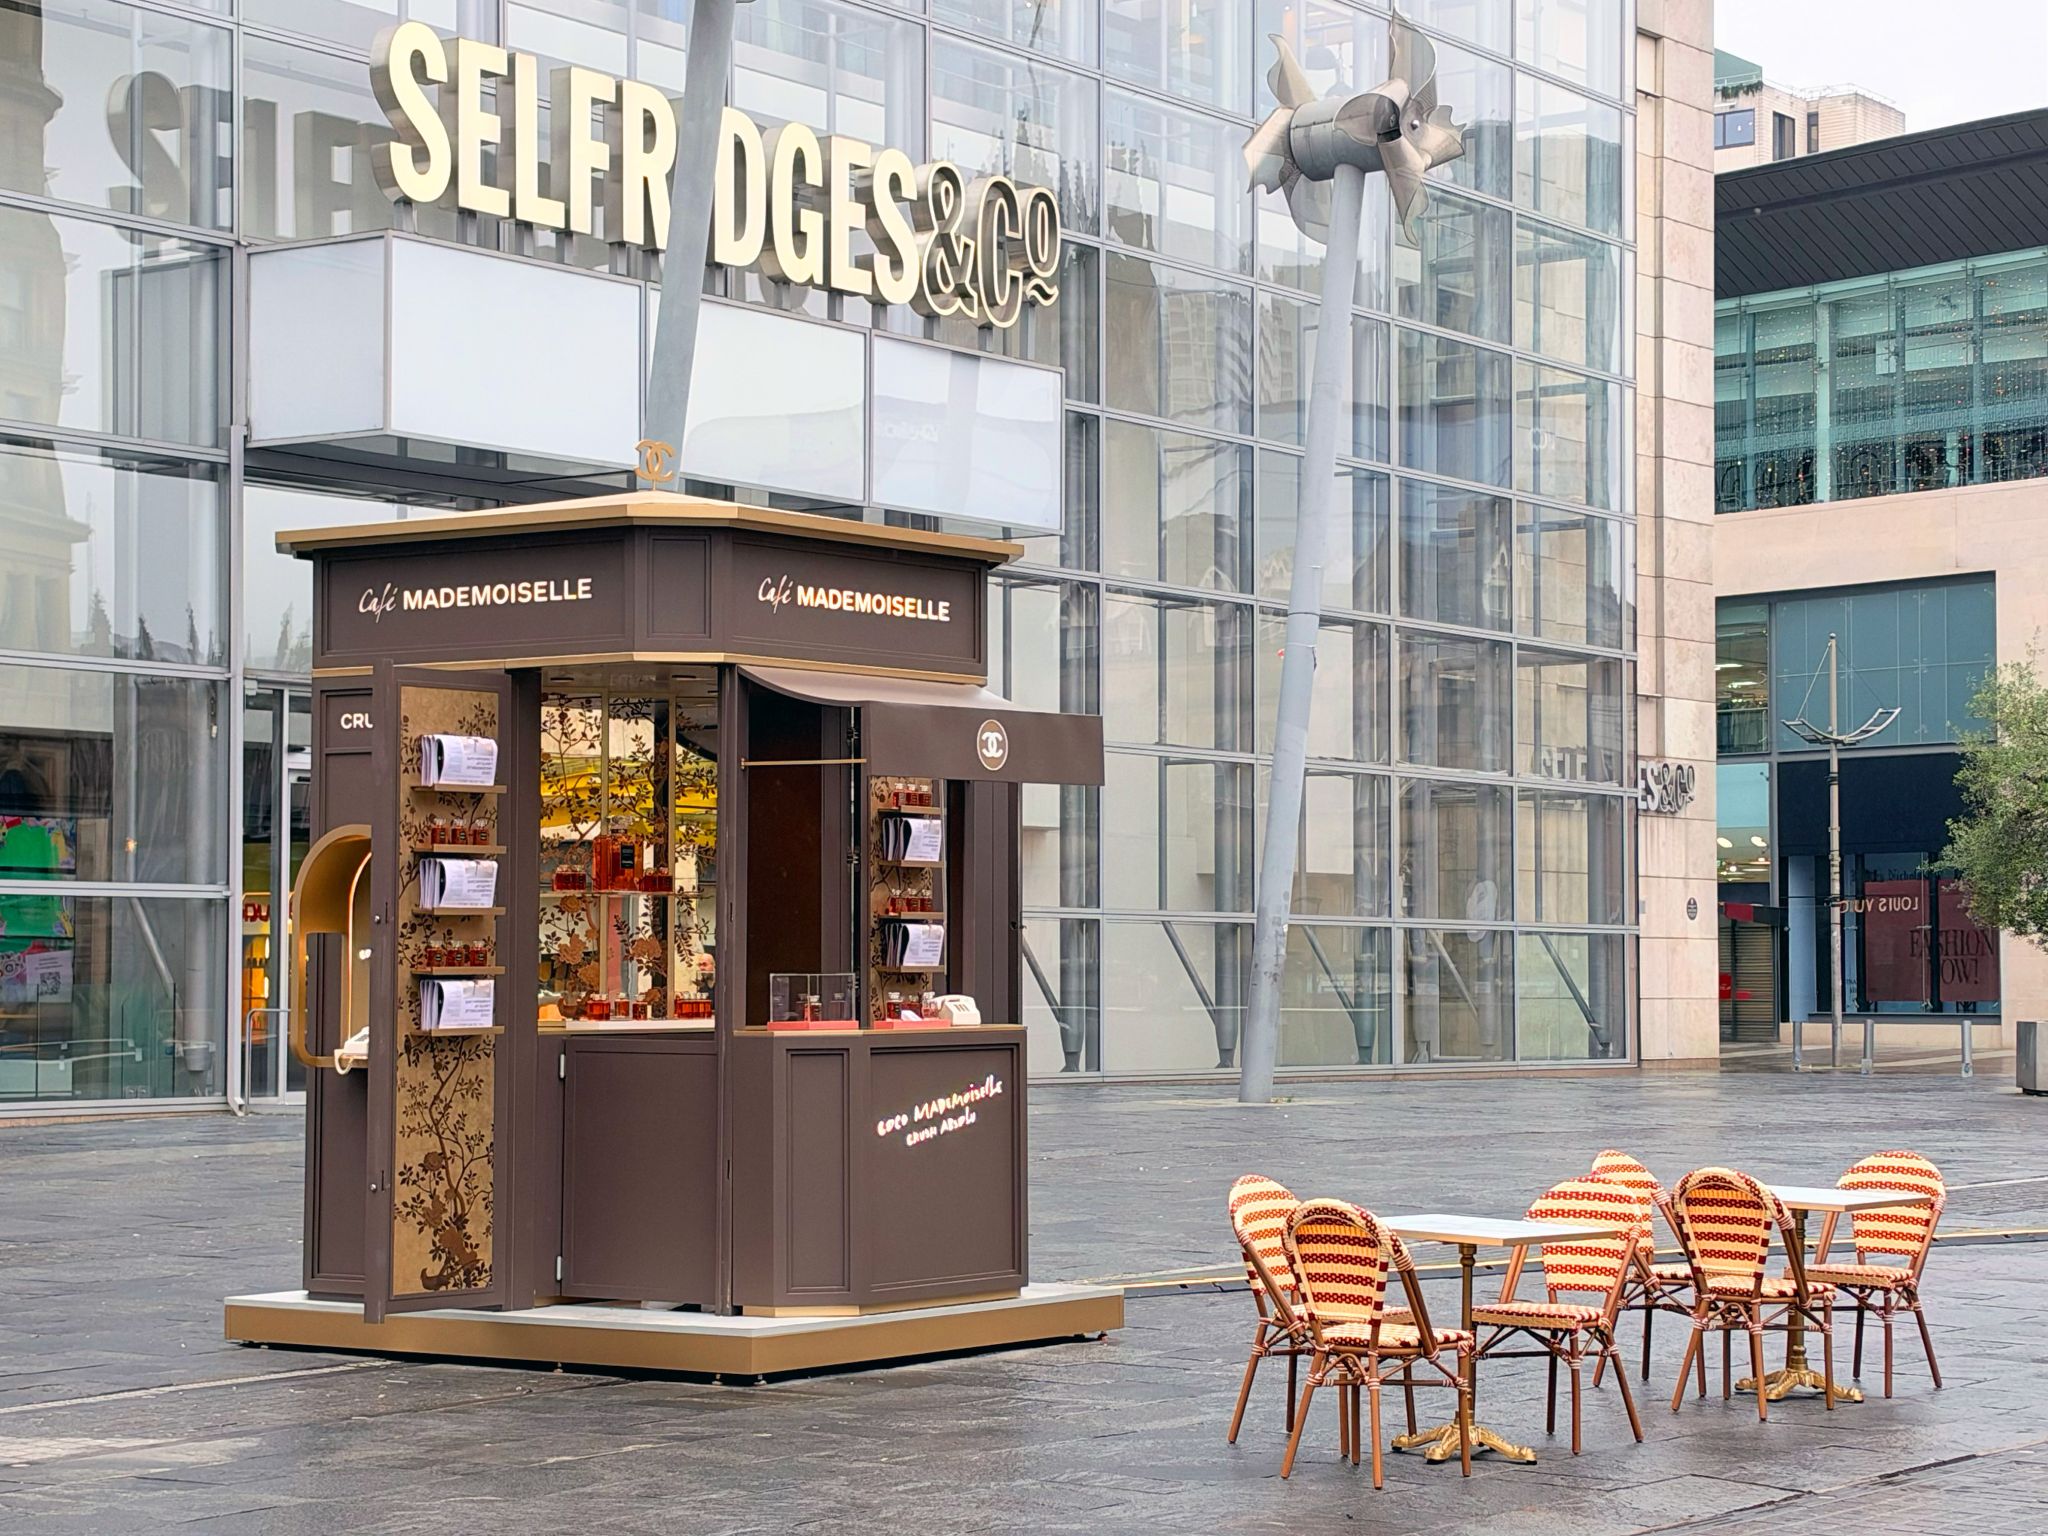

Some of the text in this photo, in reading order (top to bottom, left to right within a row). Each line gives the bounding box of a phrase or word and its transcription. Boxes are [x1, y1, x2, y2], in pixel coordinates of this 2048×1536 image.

[358, 577, 593, 623] Café MADEMOISELLE
[758, 574, 951, 622] Café MADEMOISELLE
